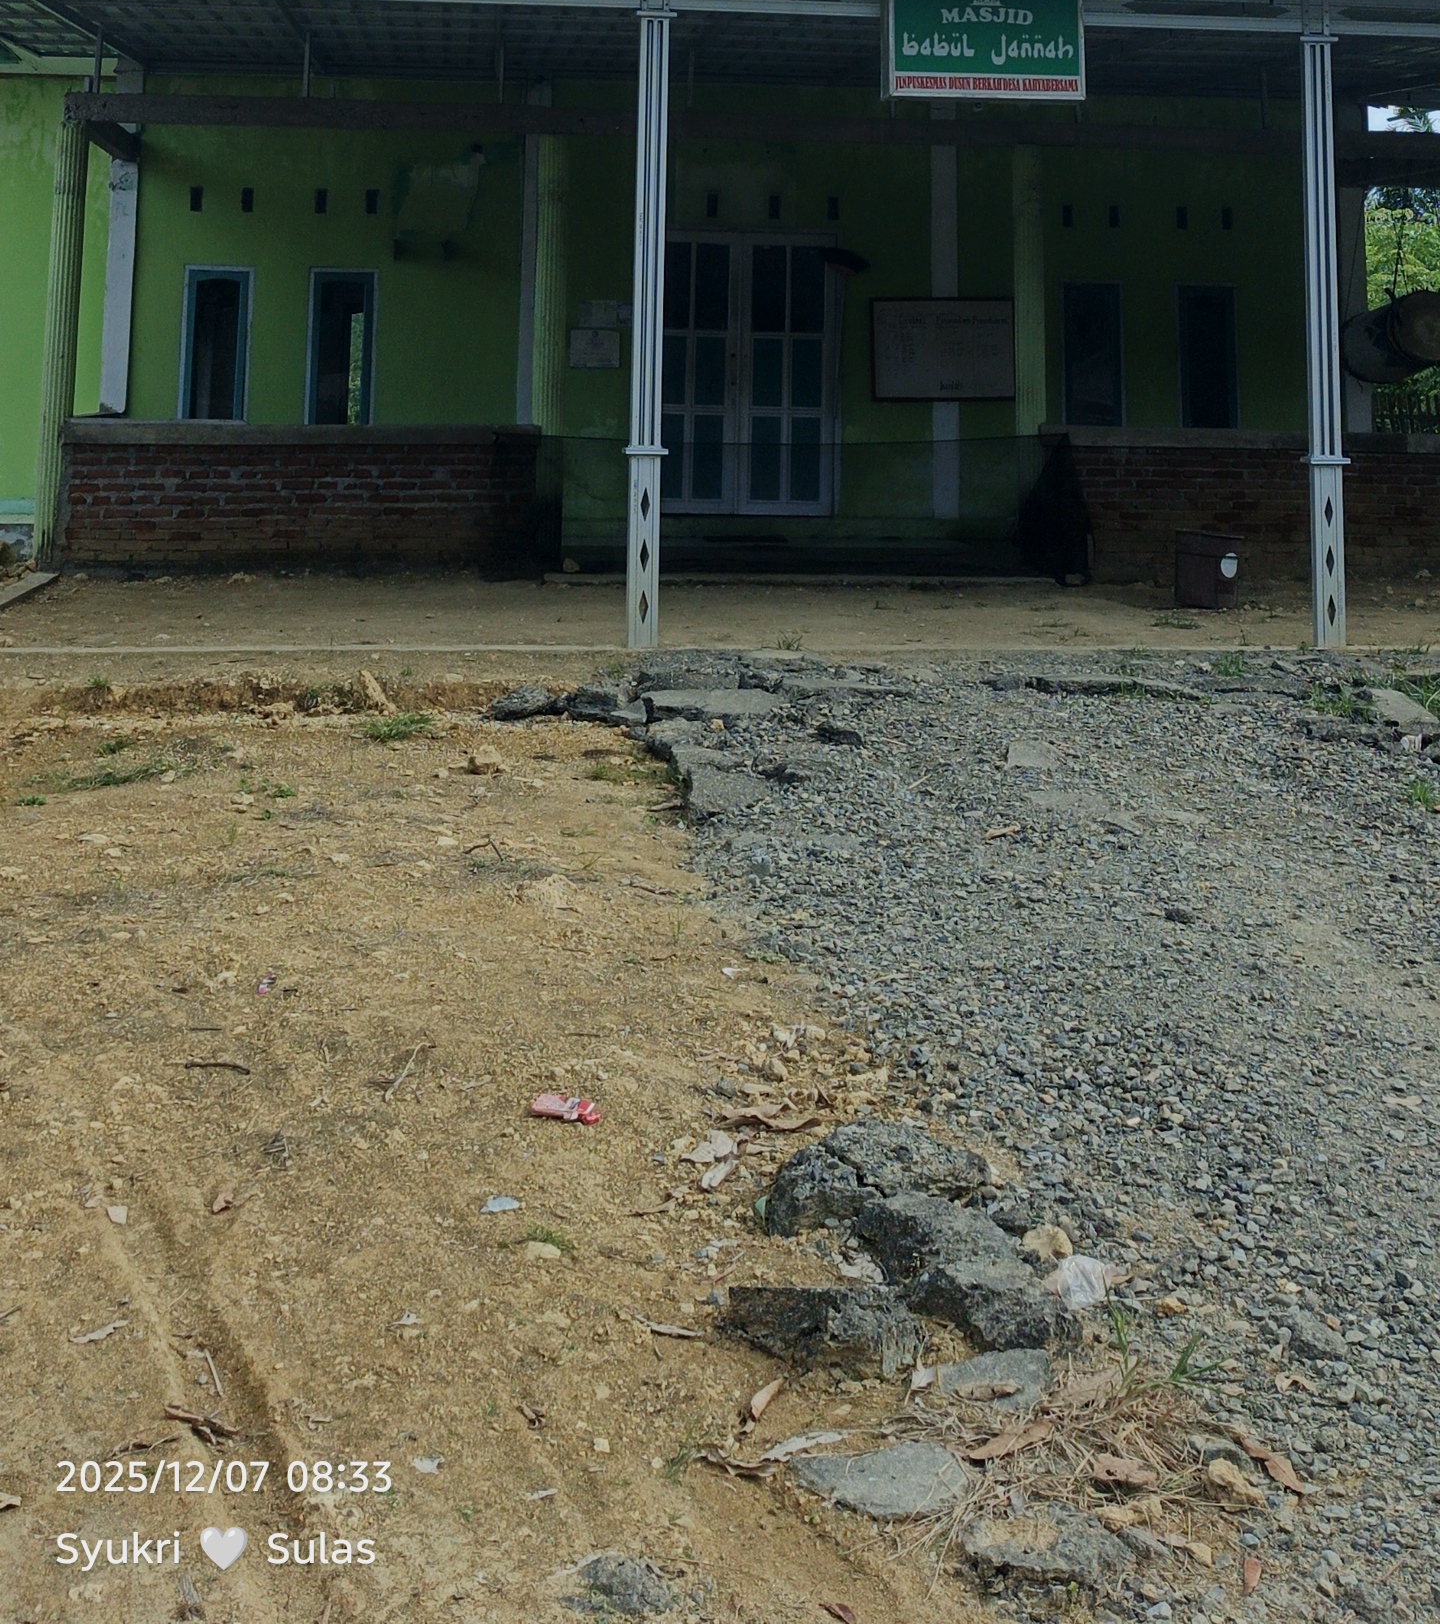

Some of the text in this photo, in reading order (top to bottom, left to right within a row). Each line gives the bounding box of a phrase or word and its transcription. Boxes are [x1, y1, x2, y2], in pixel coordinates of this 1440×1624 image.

[940, 7, 1033, 25] MASJID
[948, 77, 971, 90] DUSUN
[972, 77, 1002, 91] BERKAH
[1002, 78, 1021, 92] DESA
